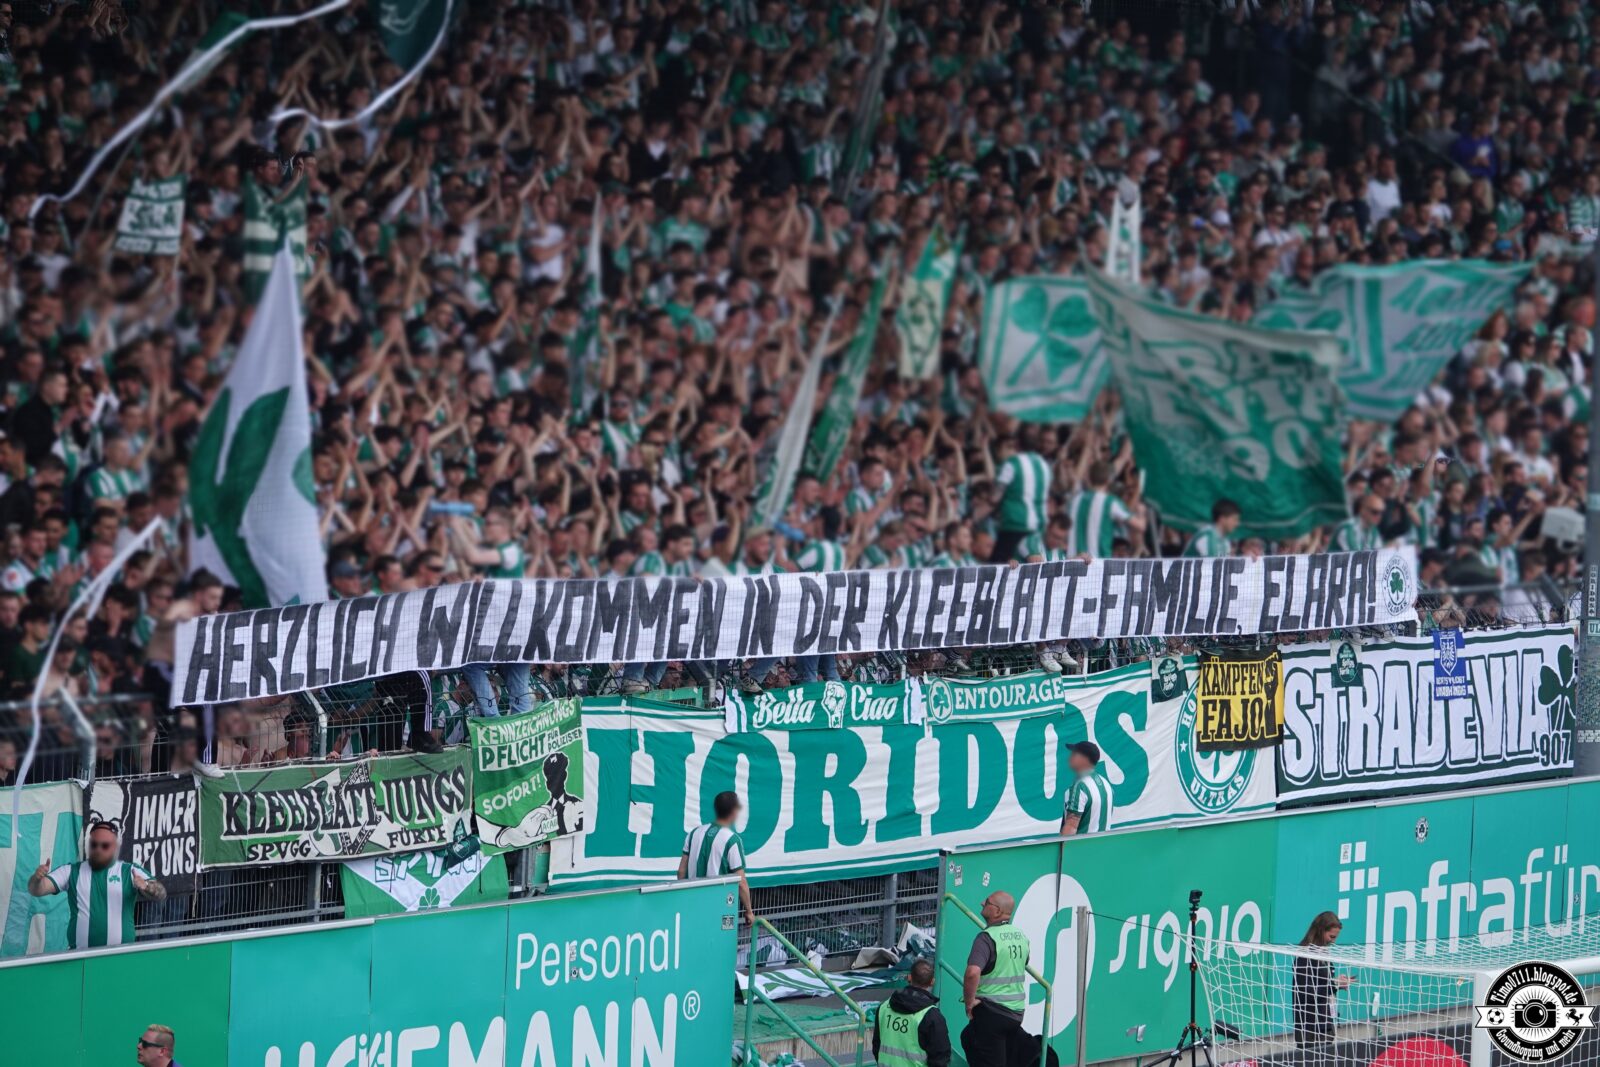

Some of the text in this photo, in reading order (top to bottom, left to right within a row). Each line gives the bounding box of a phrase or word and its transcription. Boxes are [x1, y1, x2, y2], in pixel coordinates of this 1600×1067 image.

[182, 592, 409, 703] HERZLICH
[416, 577, 727, 668] WILLKOMMEN
[737, 574, 781, 656] IN
[793, 571, 870, 654] DER
[1259, 551, 1378, 633] ELARA!
[953, 678, 1065, 710] ENTOURAGE
[1201, 656, 1265, 697] KÄMPFEN
[477, 699, 575, 746] KENNZEICHNUNGS
[753, 684, 899, 727] Bella Ciao
[1200, 697, 1264, 741] FAJO
[1283, 650, 1550, 780] STRADEVIA
[481, 733, 546, 770] PFLICHT
[1539, 731, 1571, 768] 907
[482, 774, 542, 815] SOFORT!
[584, 700, 1149, 858] HORIDOS
[1190, 775, 1245, 807] ULTRAS
[133, 789, 196, 840] IMMER
[161, 836, 196, 877] UNS
[248, 840, 312, 861] SPVGG
[515, 912, 681, 990] Personal
[1008, 944, 1023, 960] 131
[886, 1014, 909, 1034] 168
